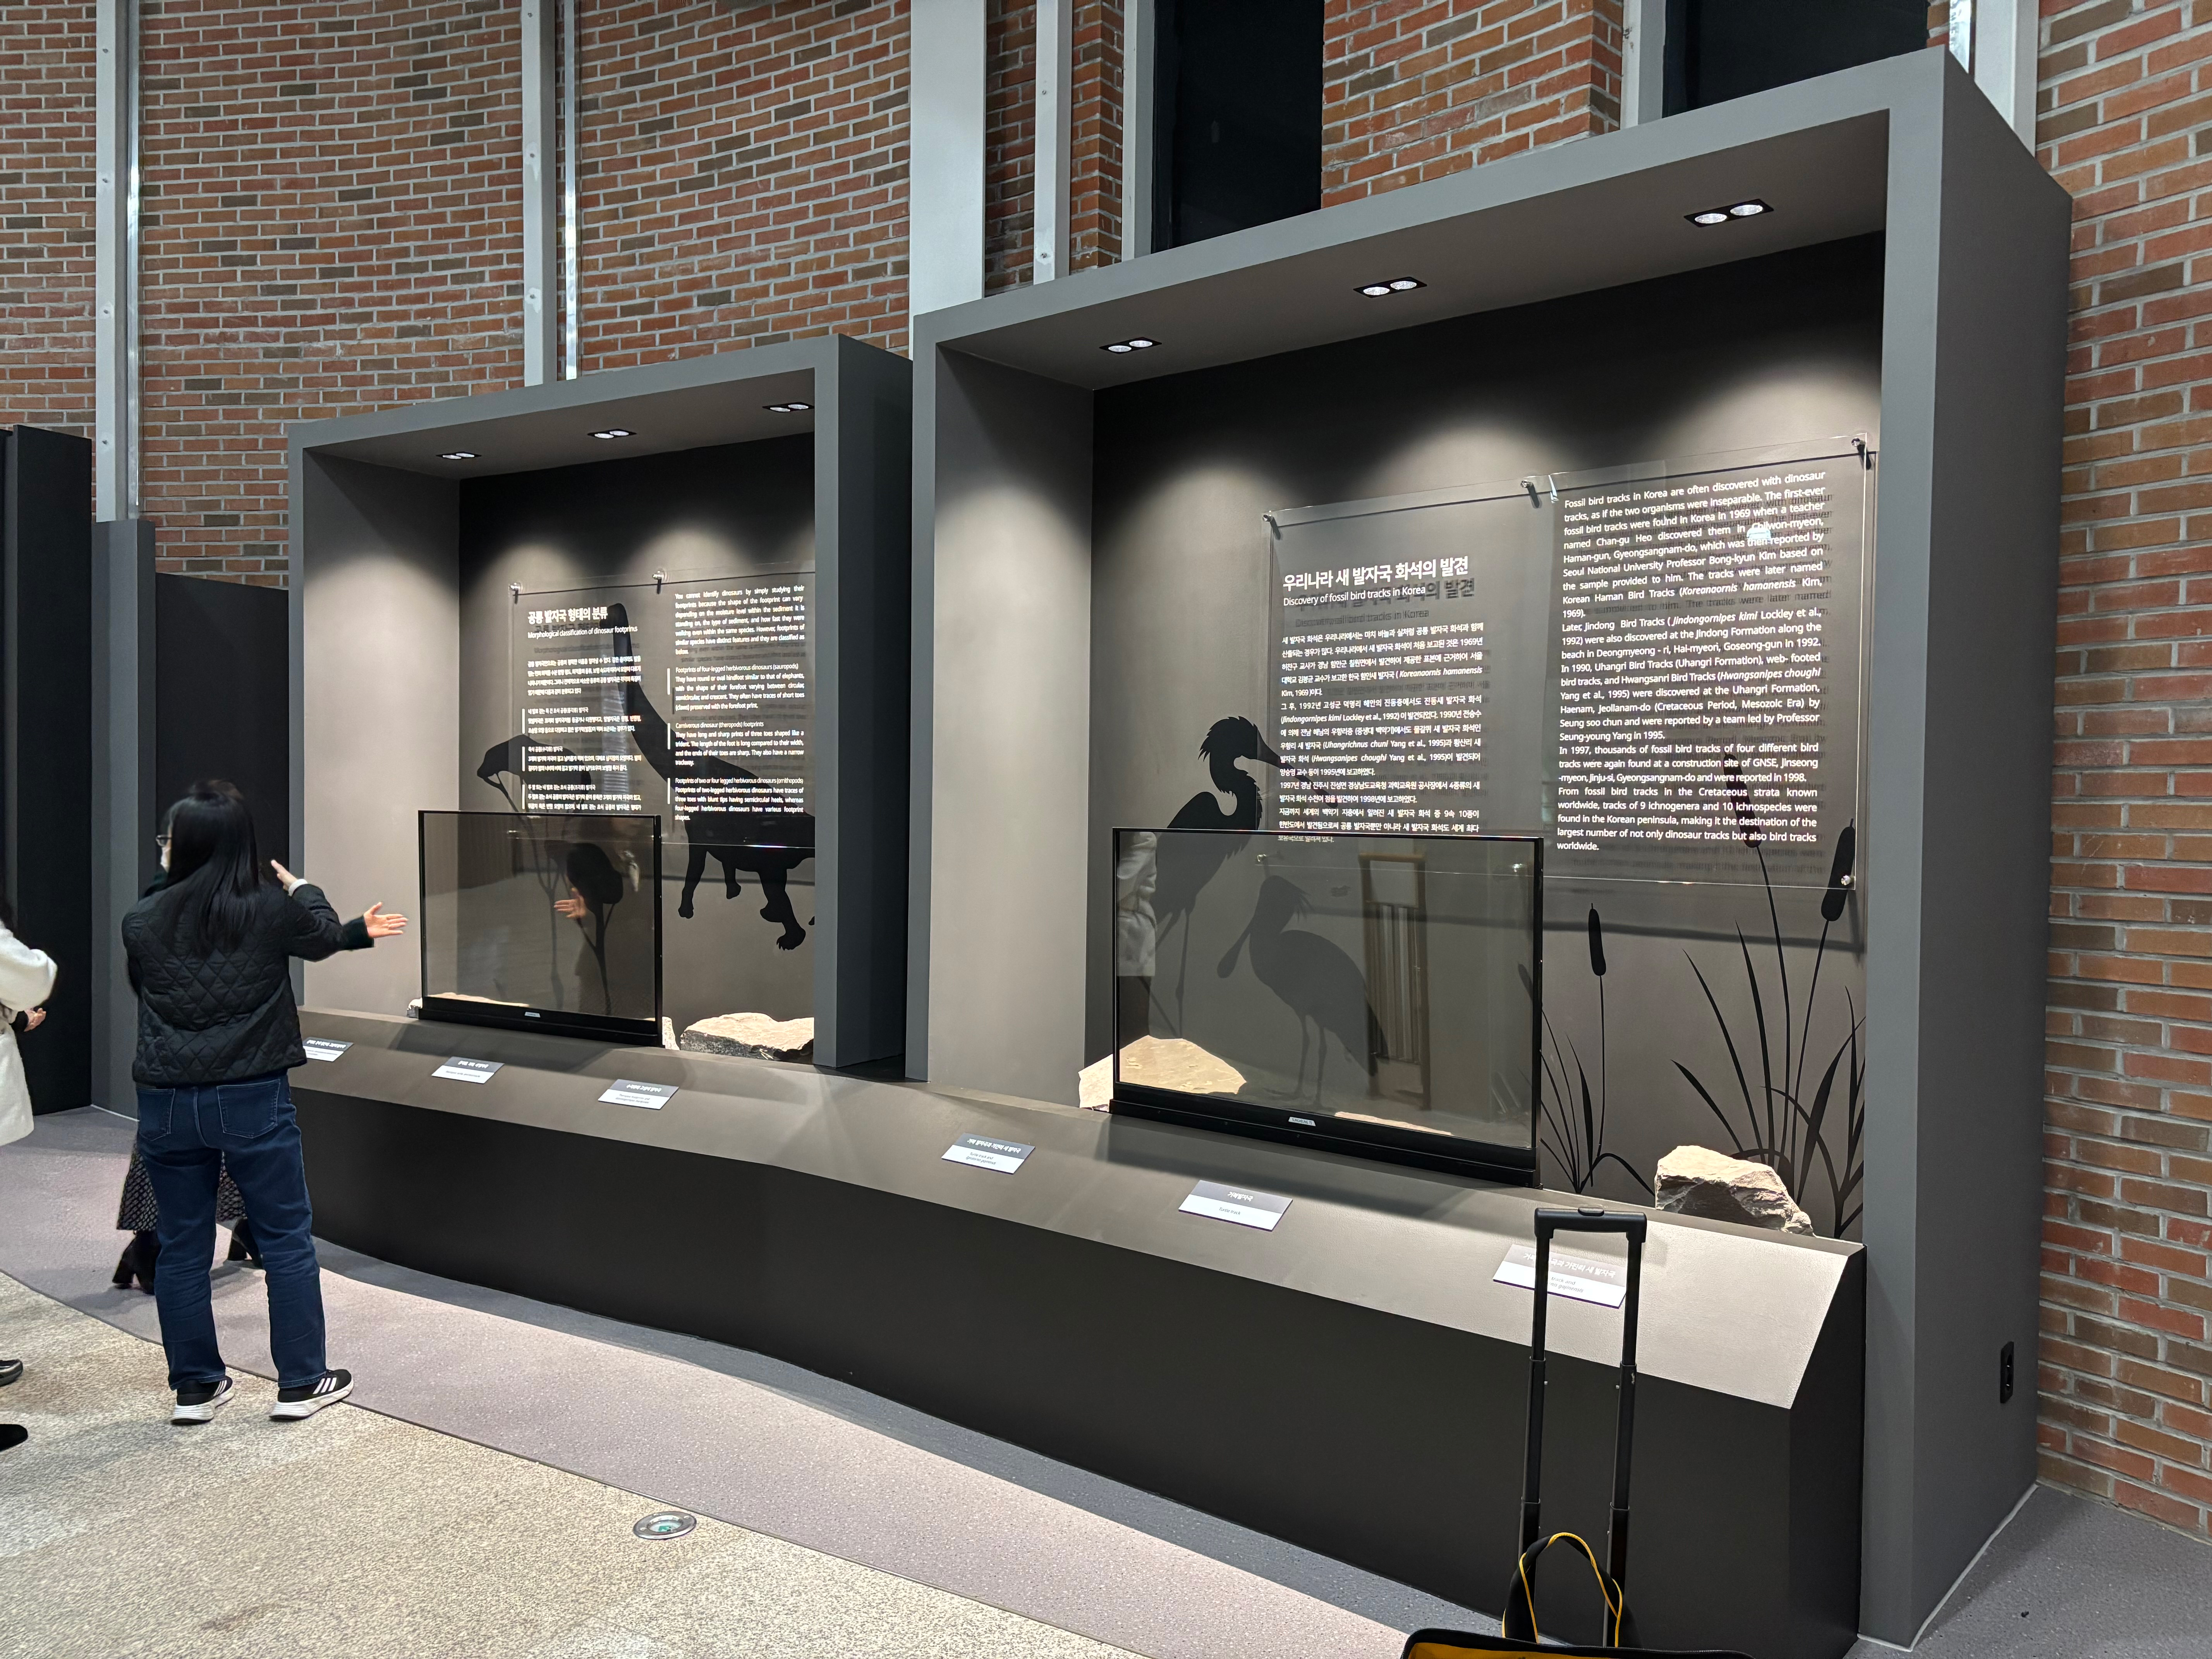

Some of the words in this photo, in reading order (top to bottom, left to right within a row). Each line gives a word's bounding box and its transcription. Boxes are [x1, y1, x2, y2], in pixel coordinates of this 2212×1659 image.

[1565, 498, 1585, 508] Fossil
[1589, 496, 1604, 505] bird
[1607, 493, 1630, 503] tracks
[1633, 492, 1641, 501] in
[1644, 490, 1668, 499] Korea
[1670, 488, 1685, 496] are
[1687, 485, 1710, 495] often
[1712, 477, 1759, 491] discovered
[1761, 475, 1782, 487] with
[1784, 472, 1825, 483] dinosaur
[1563, 567, 1584, 577] Seoul
[1587, 564, 1620, 575] National
[1623, 561, 1664, 572] University
[1666, 558, 1706, 568] Professor
[1709, 553, 1755, 565] Bong-kyun
[1759, 551, 1776, 560] Kim
[1779, 547, 1807, 559] based
[1810, 548, 1824, 556] on
[1283, 570, 1334, 592] 우리나라
[1335, 568, 1349, 586] 새
[1353, 565, 1393, 586] 발자국
[1395, 559, 1436, 580] 화석의
[1440, 556, 1468, 577] 발견
[1283, 596, 1319, 606] Discovery
[1320, 593, 1329, 603] of
[1329, 591, 1348, 602] fossil
[1350, 590, 1366, 600] bird
[1367, 588, 1391, 599] tracks
[1393, 587, 1400, 596] in
[1402, 586, 1426, 596] Korea
[1563, 596, 1590, 605] Korean
[1595, 593, 1623, 602] Haman
[1628, 590, 1645, 599] Bird
[1649, 588, 1675, 598] Tracks
[1679, 583, 1738, 597] (Koreanaornis
[1743, 579, 1796, 591] hamanensis
[1802, 577, 1822, 587] Kim,
[527, 611, 544, 625] 공룡
[544, 609, 567, 623] 발자국
[567, 607, 591, 622] 형태의
[592, 606, 608, 620] 분류
[527, 630, 559, 640] Morphological
[615, 625, 638, 634] footprints
[1561, 665, 1569, 673] In
[1571, 663, 1592, 672] 1990,
[1595, 661, 1626, 672] Uhangri
[1629, 660, 1645, 670] Bird
[1647, 659, 1673, 669] Tracks
[1675, 657, 1712, 669] (Uhangri
[1714, 655, 1764, 666] Formation),
[1790, 652, 1821, 663] footed
[1299, 701, 1321, 709] 1992년
[1323, 701, 1341, 709] 고성군
[1363, 699, 1382, 708] 해안의
[1384, 697, 1422, 707] 진동층에서도
[1424, 696, 1444, 706] 진동새
[1446, 696, 1466, 705] 발자국
[1468, 694, 1482, 704] 화석
[1560, 692, 1580, 702] Yang
[1593, 690, 1605, 699] al.,
[1608, 690, 1630, 699] 1995)
[1656, 686, 1700, 697] discovered
[1703, 687, 1712, 695] at
[1715, 685, 1729, 695] the
[1733, 684, 1768, 696] Uhangri
[1771, 683, 1820, 693] Formation,
[1559, 746, 1568, 754] In
[1571, 746, 1591, 755] 1997,
[1594, 745, 1636, 754] thousands
[1639, 745, 1649, 754] of
[1651, 744, 1672, 753] fossil
[1675, 744, 1692, 753] bird
[1695, 744, 1721, 753] tracks
[1724, 744, 1734, 752] of
[1736, 743, 1755, 752] four
[1759, 743, 1797, 752] different
[1800, 742, 1819, 752] bird
[1584, 787, 1605, 795] fossil
[1611, 787, 1627, 795] bird
[1633, 787, 1658, 796] tracks
[1664, 787, 1672, 796] in
[1678, 787, 1693, 796] the
[1698, 787, 1748, 796] Cretaceous
[1753, 788, 1780, 797] strata
[1787, 787, 1817, 797] known
[1557, 842, 1599, 850] worldwide.
[1565, 1261, 1586, 1272] 가진리
[1585, 1266, 1594, 1274] 새
[1594, 1267, 1616, 1278] 발자국
[1558, 1283, 1584, 1293] gajinensis
